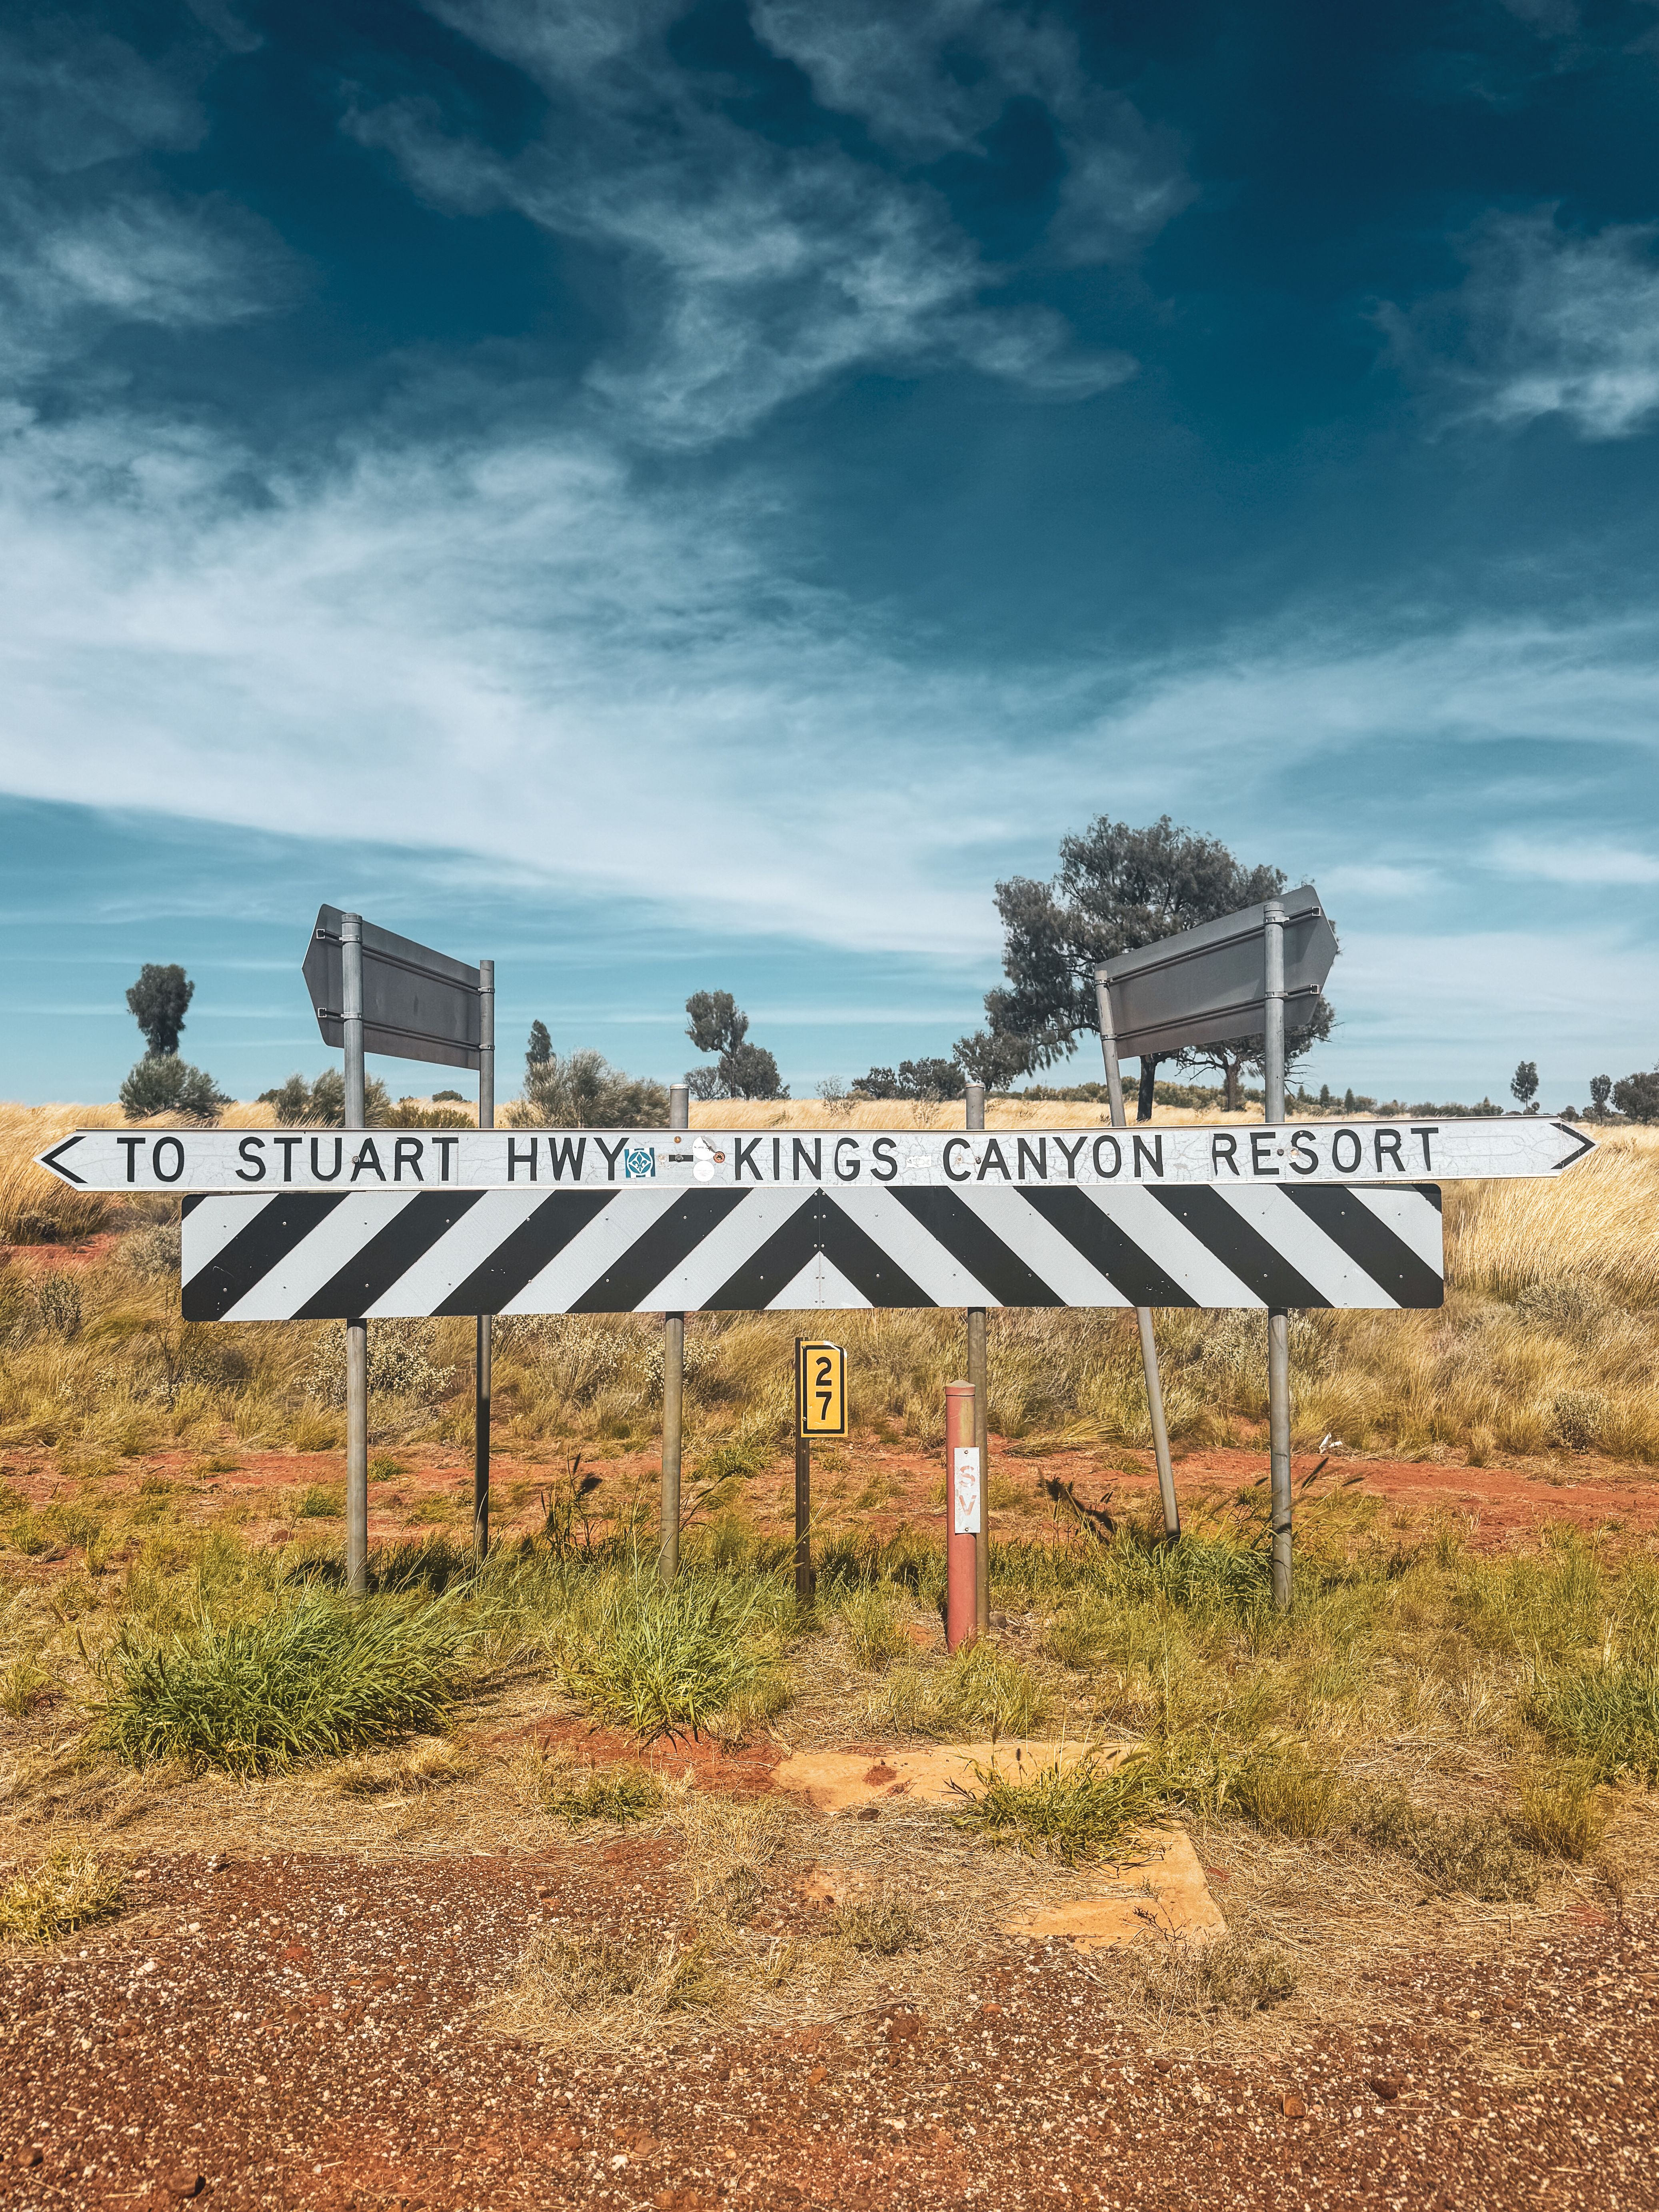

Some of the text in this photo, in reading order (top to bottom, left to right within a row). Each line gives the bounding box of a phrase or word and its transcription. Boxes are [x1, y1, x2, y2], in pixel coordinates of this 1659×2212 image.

[116, 1136, 185, 1183] TO
[235, 1136, 459, 1183] STUART
[507, 1137, 630, 1181] HWY
[734, 1137, 898, 1181] KINGS
[942, 1135, 1164, 1181] CANYON
[1211, 1127, 1439, 1176] RESORT
